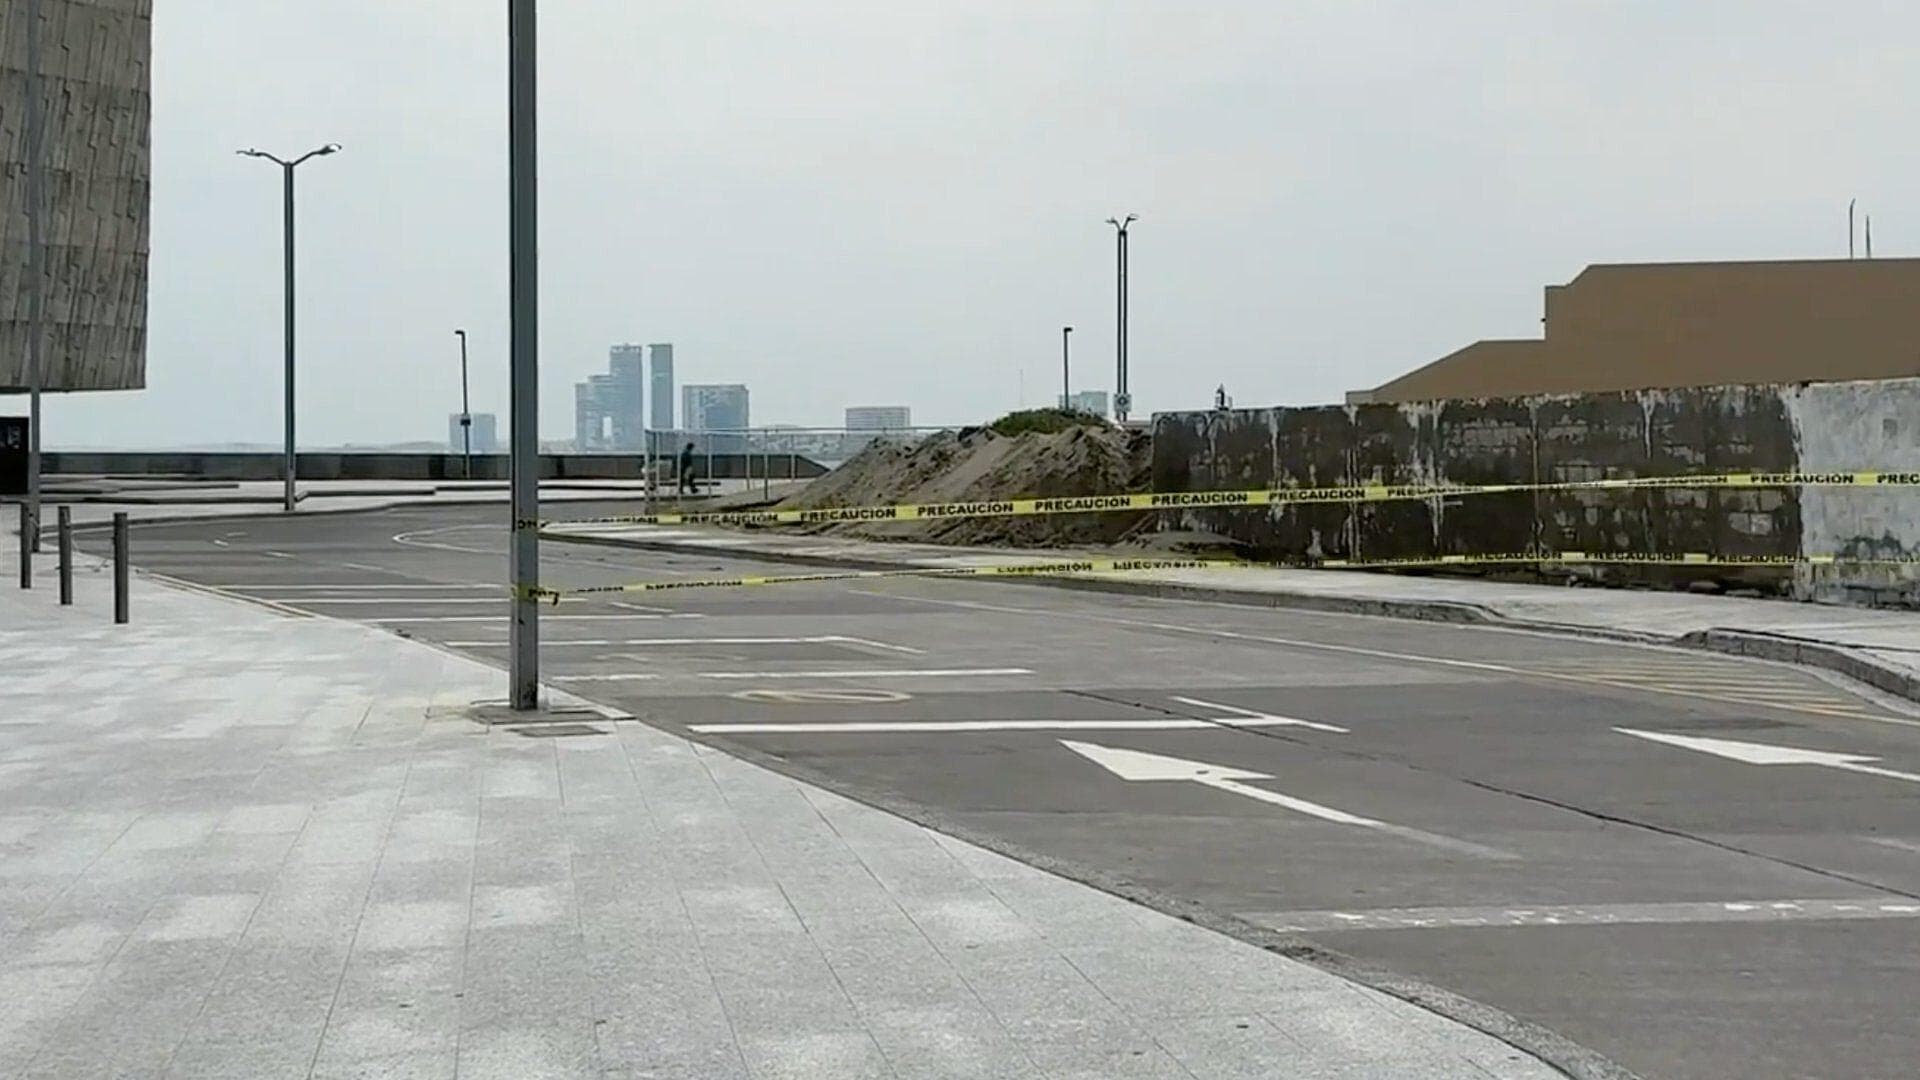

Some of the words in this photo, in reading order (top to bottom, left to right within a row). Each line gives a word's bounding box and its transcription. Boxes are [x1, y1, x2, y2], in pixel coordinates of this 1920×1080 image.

[800, 507, 896, 523] PRECAUCION
[917, 502, 1014, 517] PRECAUCION
[1035, 497, 1131, 511] PRECAUCION
[1151, 492, 1248, 505] PRECAUCION
[1269, 488, 1366, 501] PRECAUCION
[1750, 473, 1854, 484] PRECAUCION
